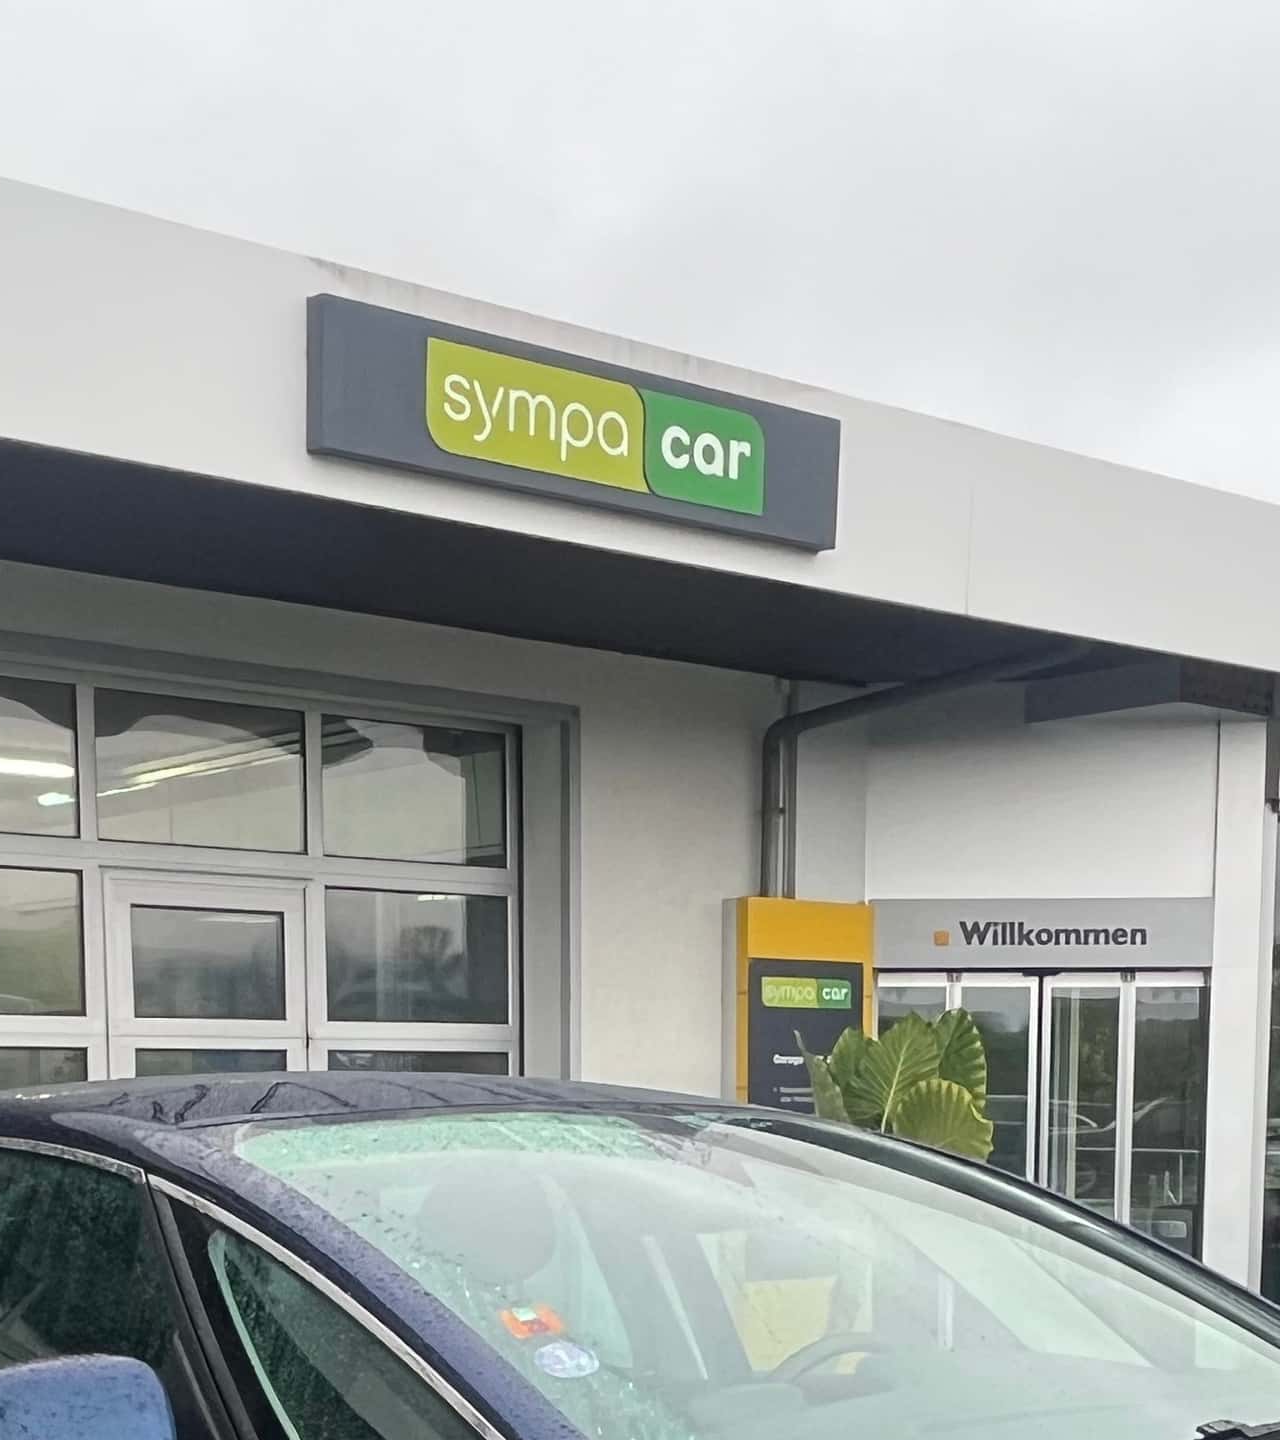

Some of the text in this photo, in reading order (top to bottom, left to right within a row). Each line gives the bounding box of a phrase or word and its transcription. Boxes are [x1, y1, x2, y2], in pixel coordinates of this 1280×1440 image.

[442, 373, 751, 480] sympa car
[959, 920, 1148, 946] Willkommen
[765, 984, 849, 1003] sympa car
